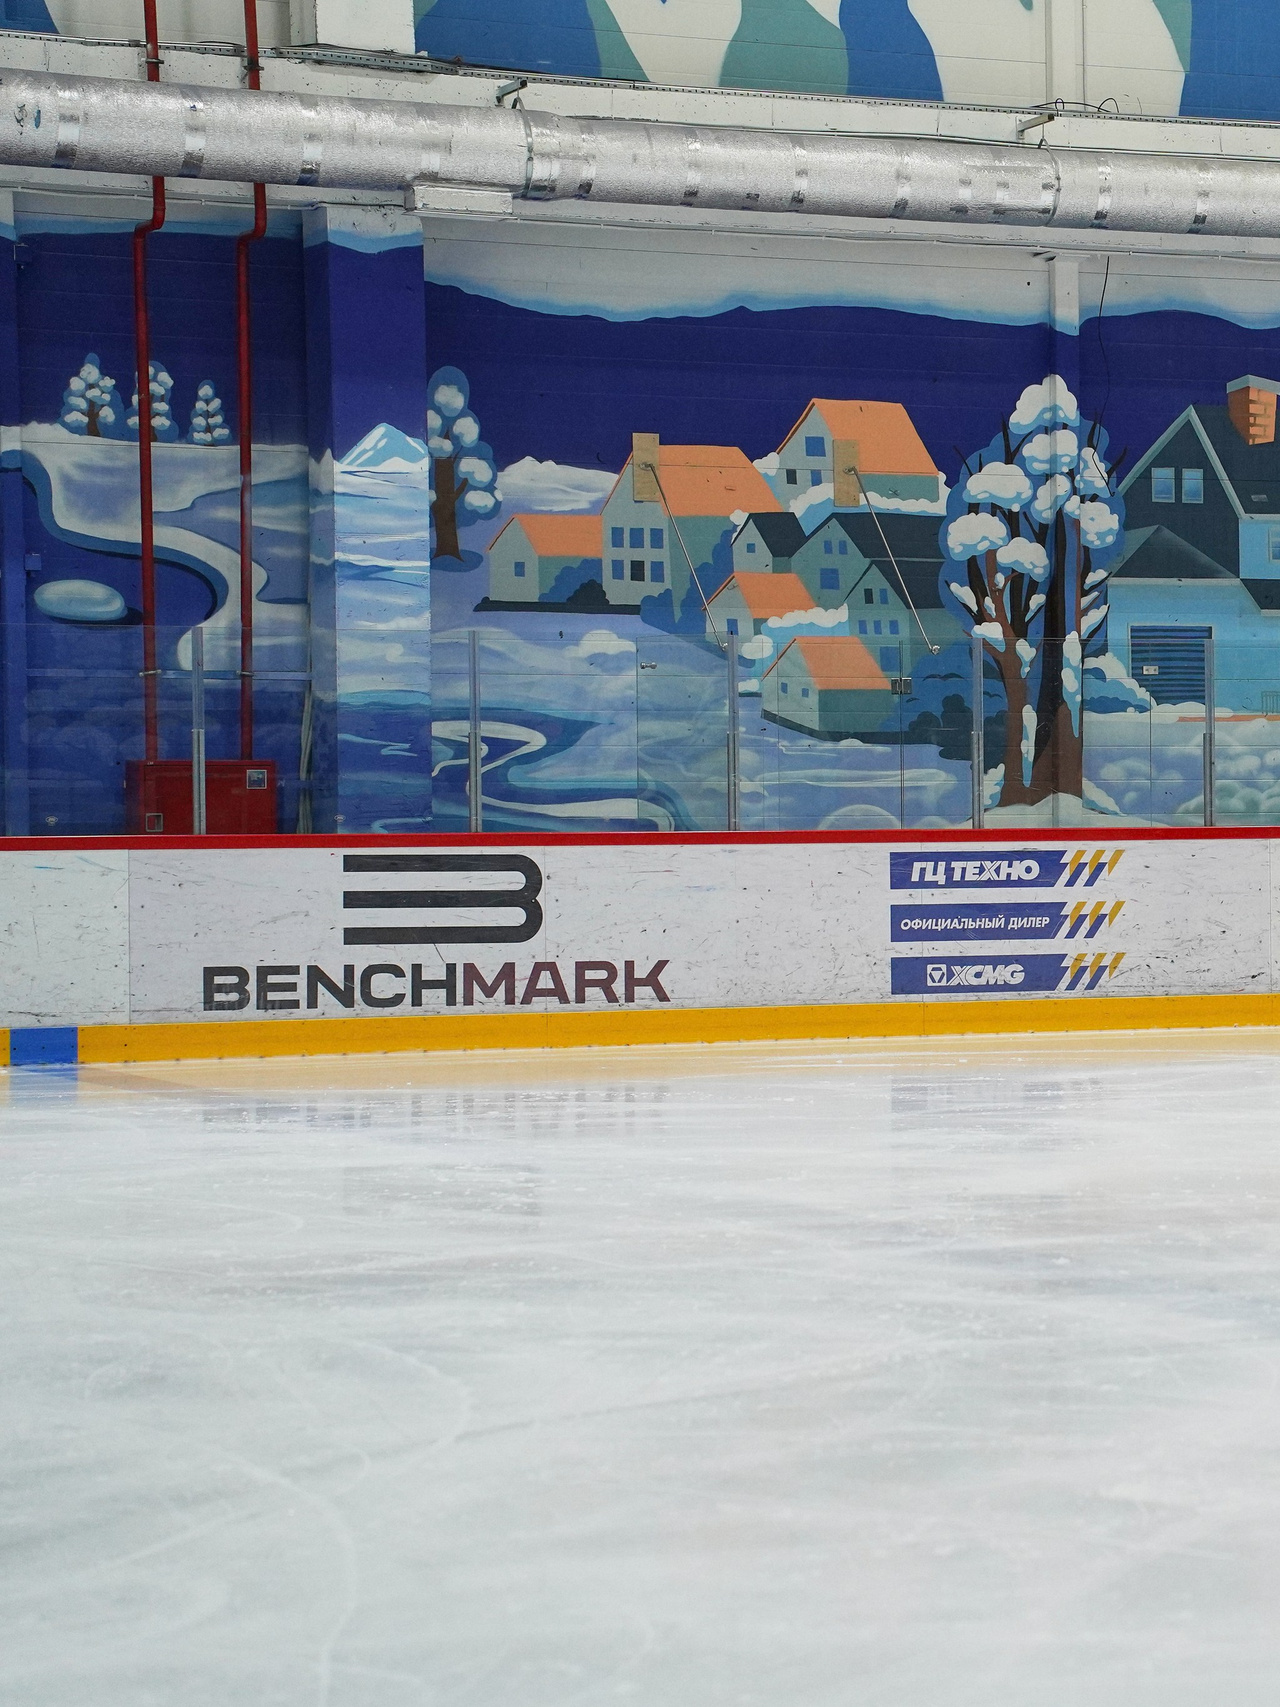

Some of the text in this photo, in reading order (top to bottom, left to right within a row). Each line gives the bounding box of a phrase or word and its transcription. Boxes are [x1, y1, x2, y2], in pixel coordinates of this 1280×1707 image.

[911, 859, 1040, 885] ГЦ ТЕХНО
[900, 915, 1050, 930] ОФИЦИАЛЬНЫЙ ДИЛЕР
[202, 959, 671, 1011] BENCHMARK
[948, 964, 1025, 986] XCMG
